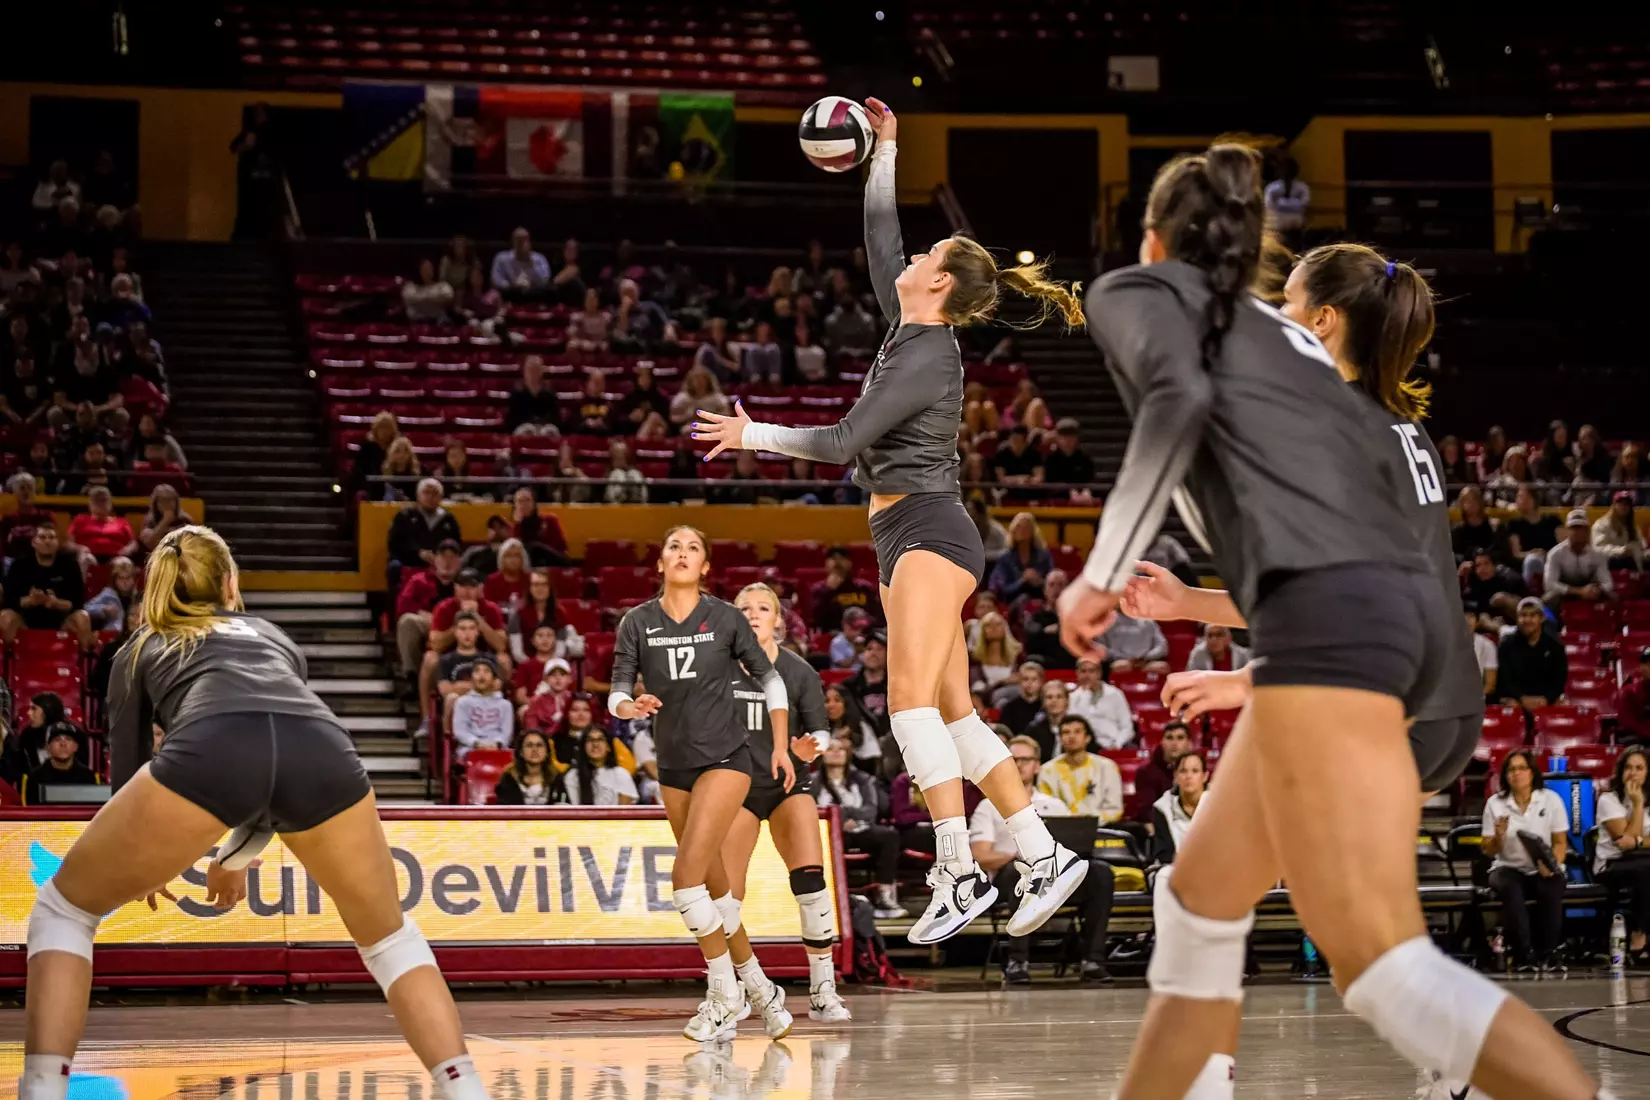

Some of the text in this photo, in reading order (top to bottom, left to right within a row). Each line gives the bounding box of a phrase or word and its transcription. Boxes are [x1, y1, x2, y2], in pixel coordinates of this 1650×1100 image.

[1390, 423, 1443, 505] 15
[647, 631, 715, 647] WASHINGTON STATE
[666, 646, 697, 681] 12
[733, 690, 766, 700] SHINGTON
[747, 702, 763, 730] 11
[176, 844, 678, 917] SuDevilV
